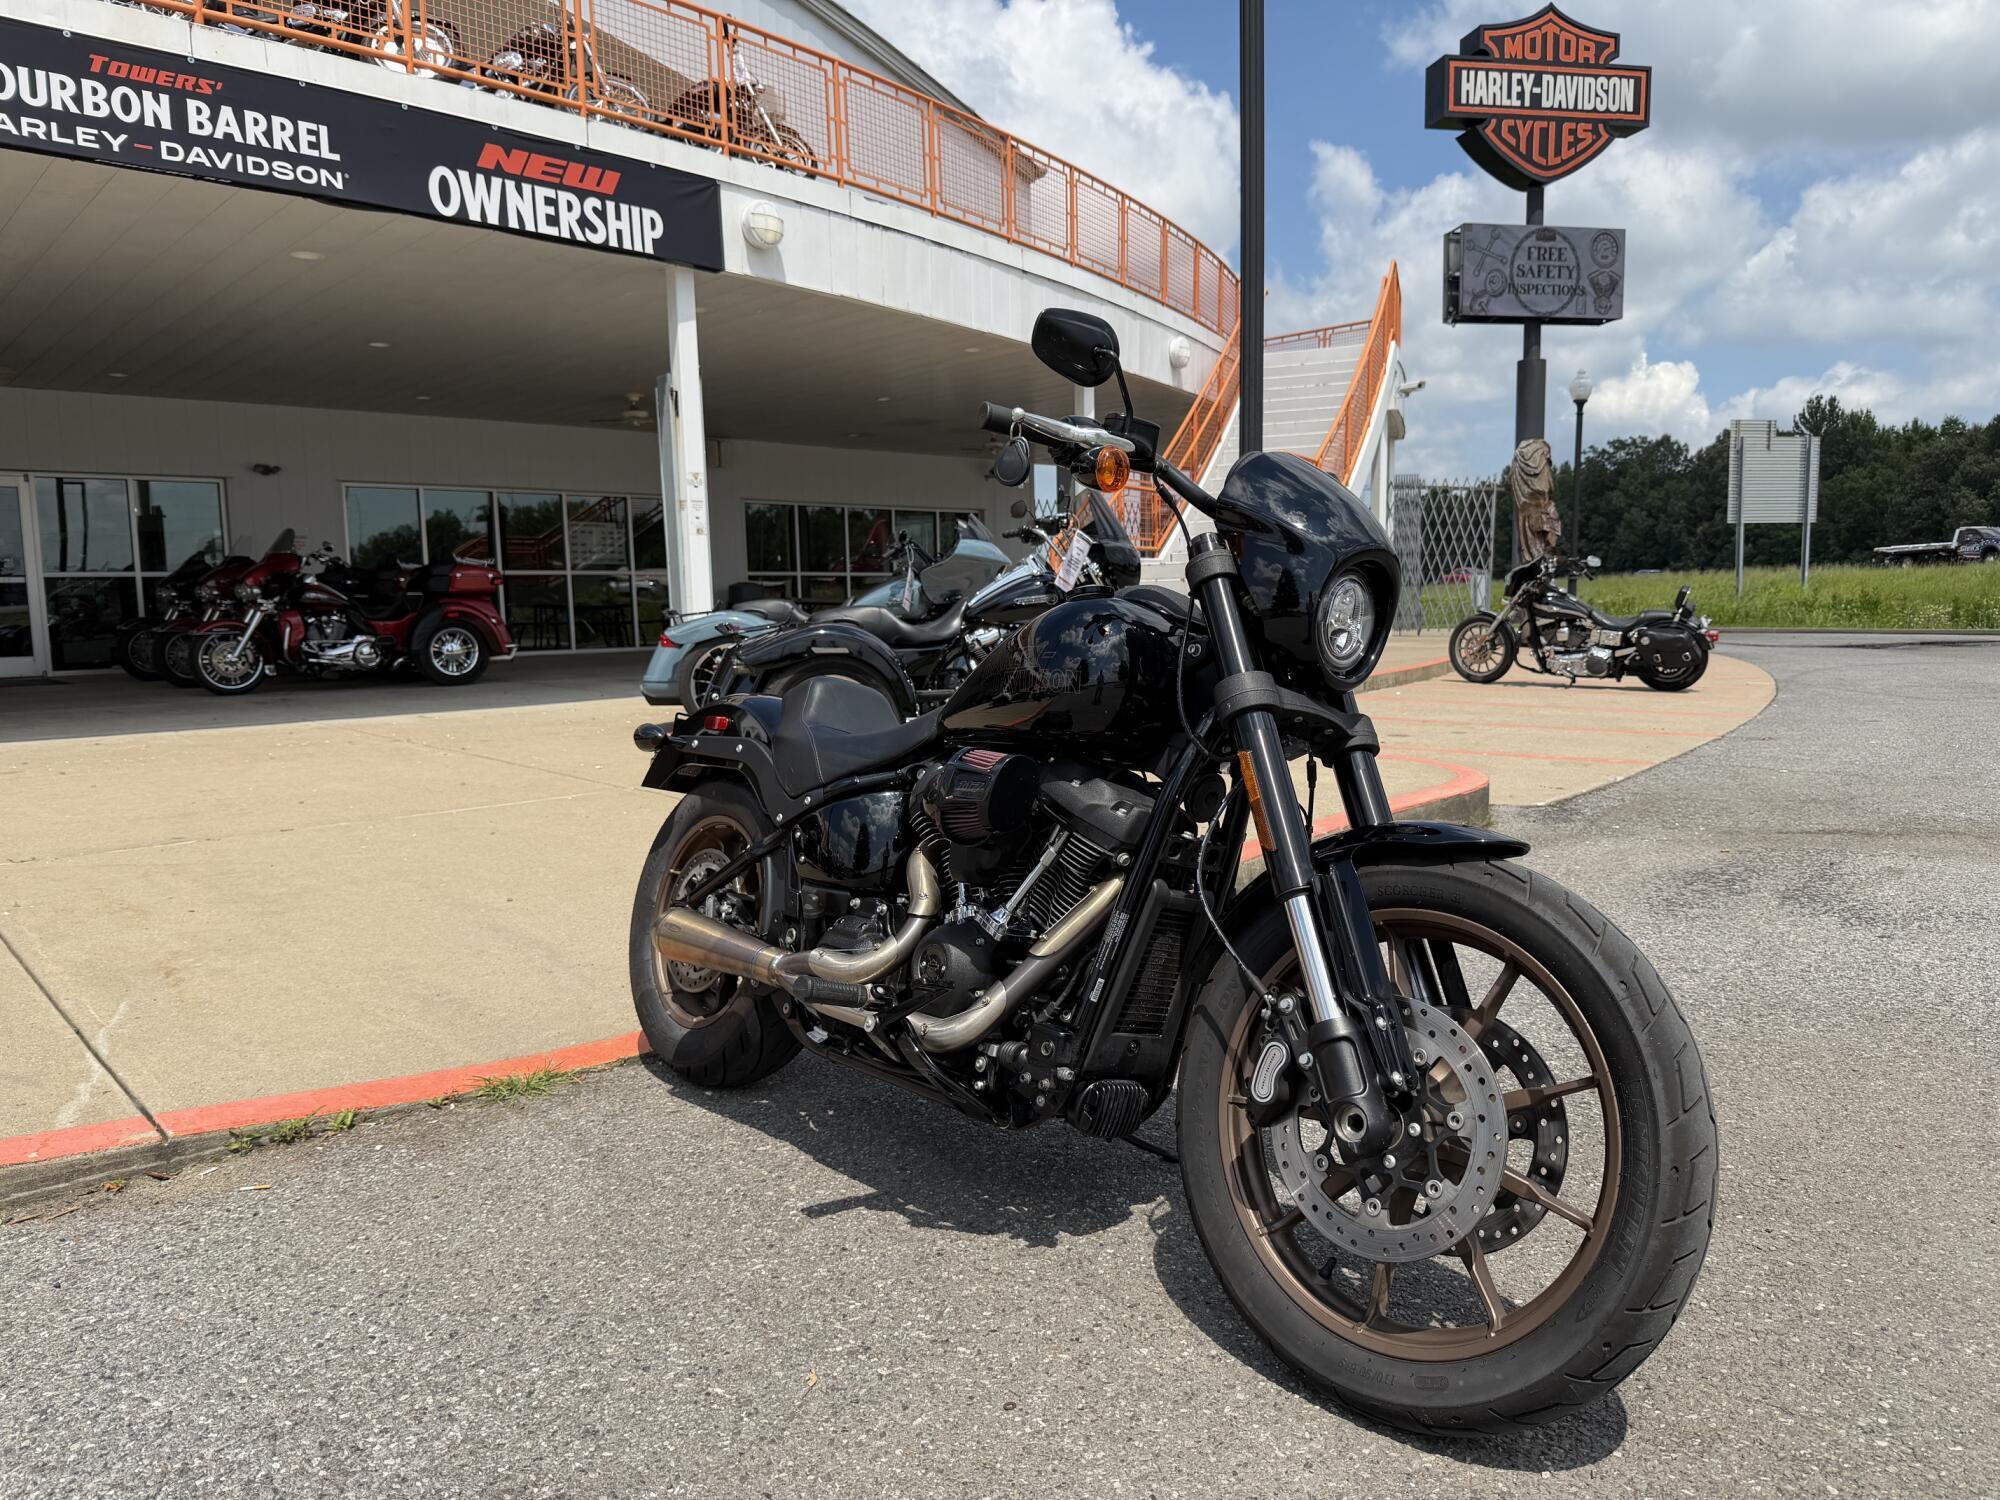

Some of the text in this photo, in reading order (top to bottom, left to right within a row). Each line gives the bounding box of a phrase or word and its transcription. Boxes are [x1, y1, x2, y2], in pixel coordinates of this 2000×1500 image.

[1504, 22, 1595, 64] MOTOR
[89, 54, 223, 95] TOWERS'
[1460, 69, 1635, 112] HARLEY-DAVIDSON
[186, 98, 340, 161] BARREL
[1502, 119, 1594, 166] CYCLES
[476, 143, 622, 195] NEW
[428, 165, 664, 255] OWNERSHIP
[1516, 263, 1576, 279] SAFETY
[1527, 246, 1568, 263] FREE
